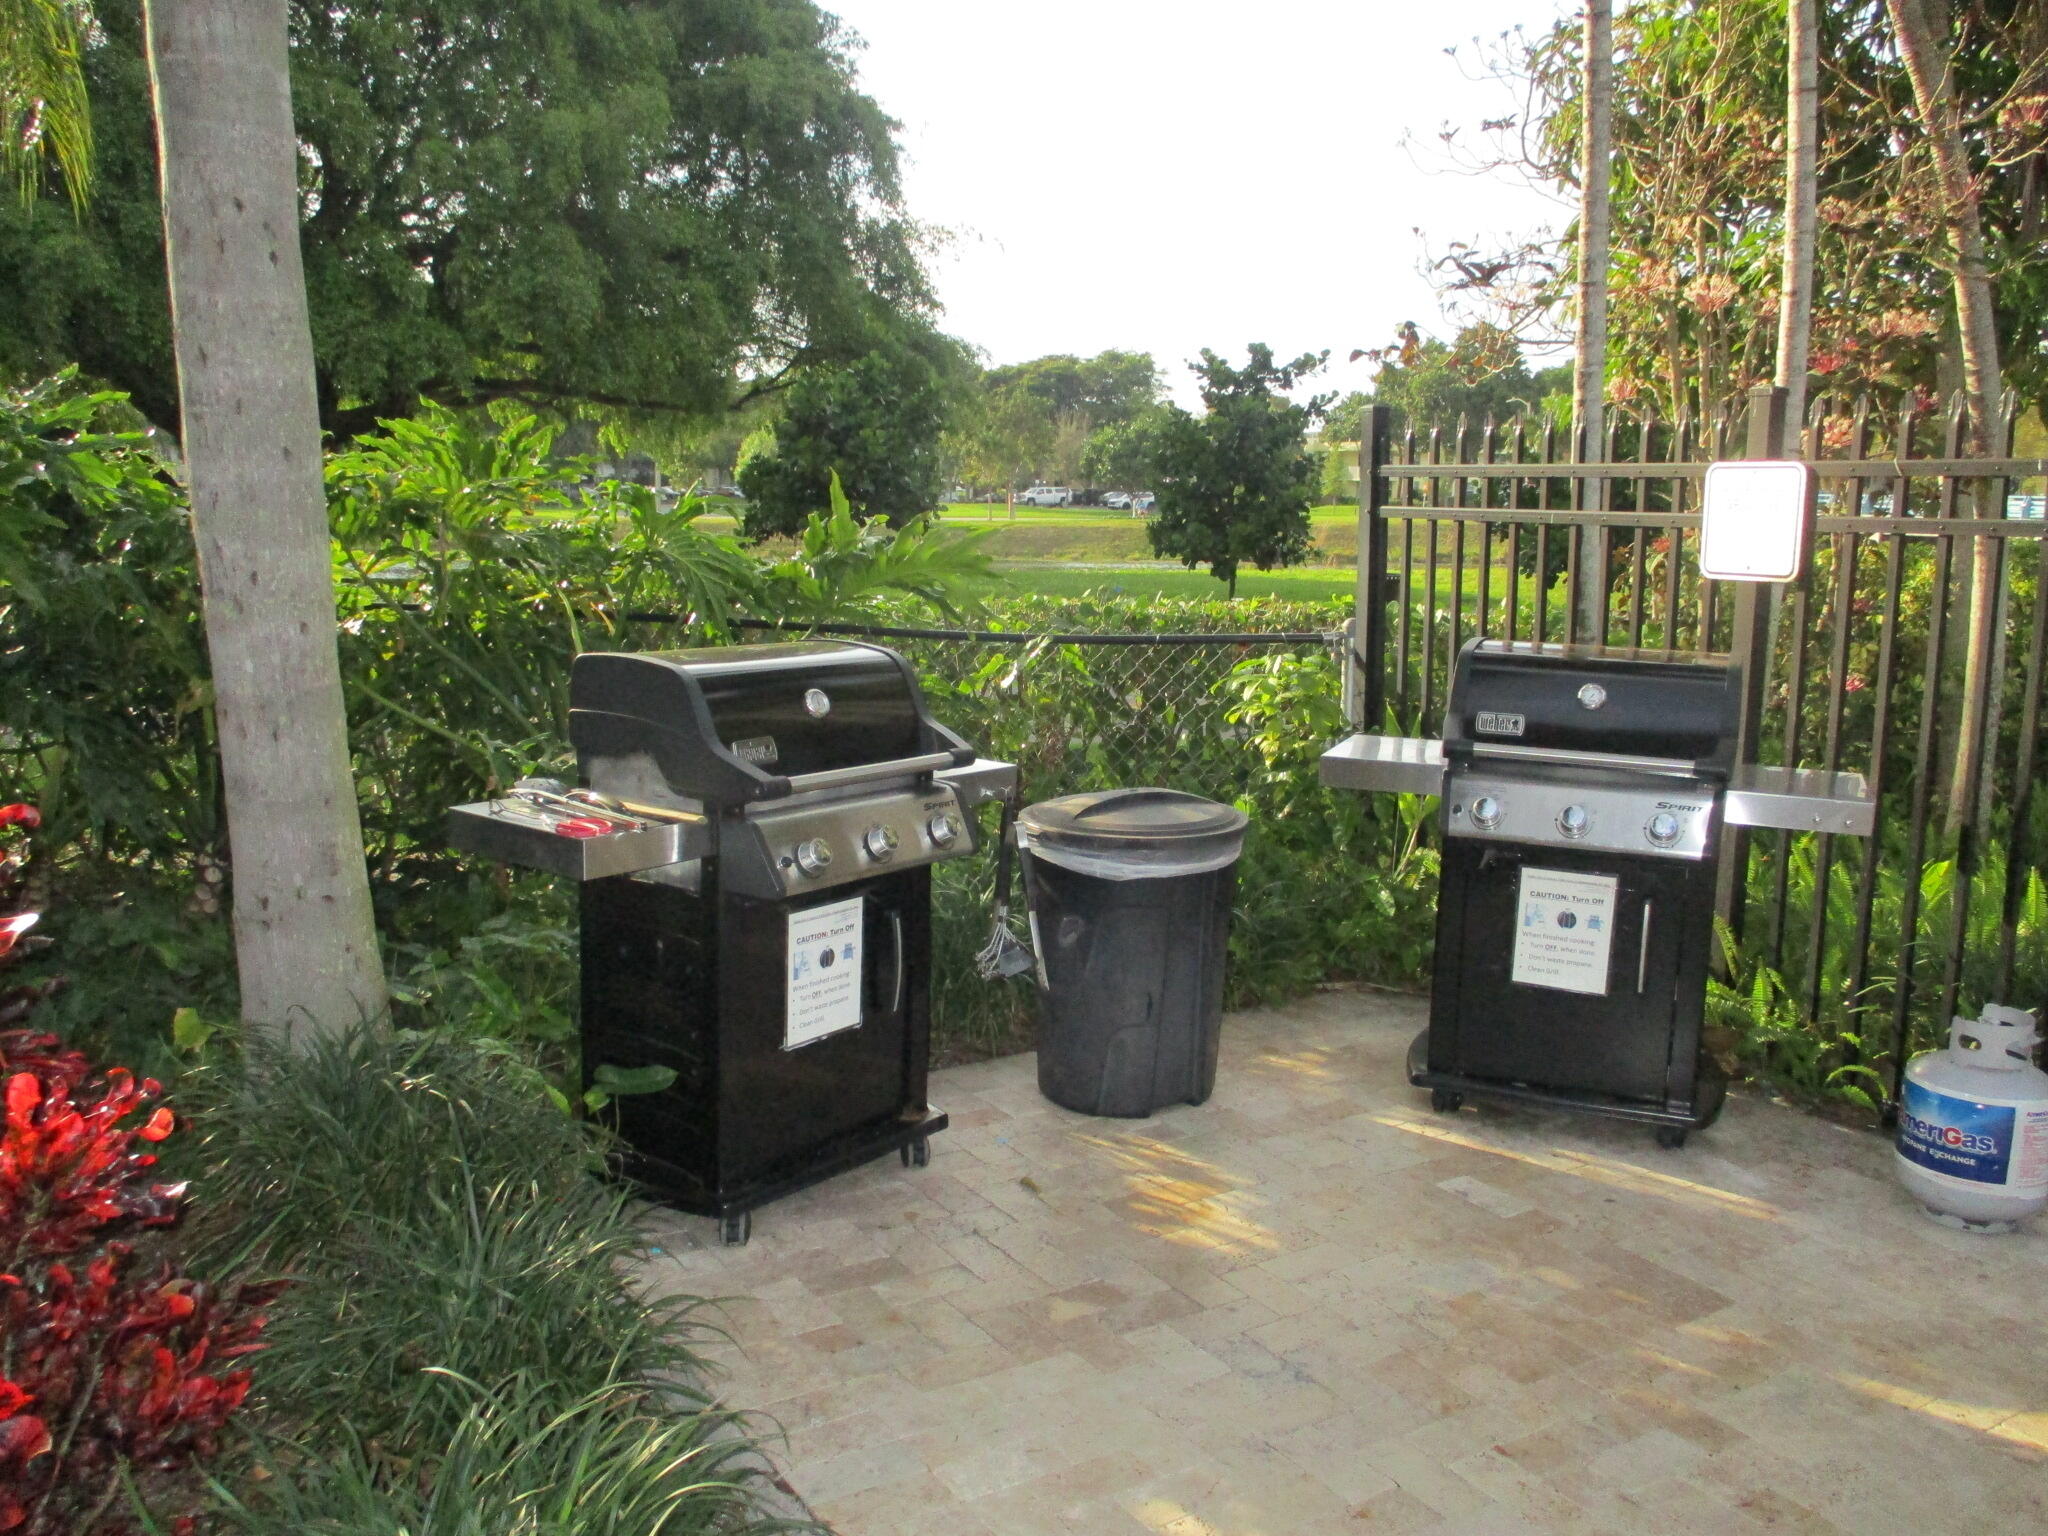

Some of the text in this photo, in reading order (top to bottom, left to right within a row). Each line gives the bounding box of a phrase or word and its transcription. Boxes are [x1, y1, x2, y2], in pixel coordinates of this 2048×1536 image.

[1655, 801, 1704, 812] SPIRIT
[1530, 890, 1569, 901] CAUTION:
[1572, 895, 1589, 904] Turn
[796, 923, 855, 945] CAUTION: Turn Off
[1929, 1148, 1976, 1166] EXCHANGE
